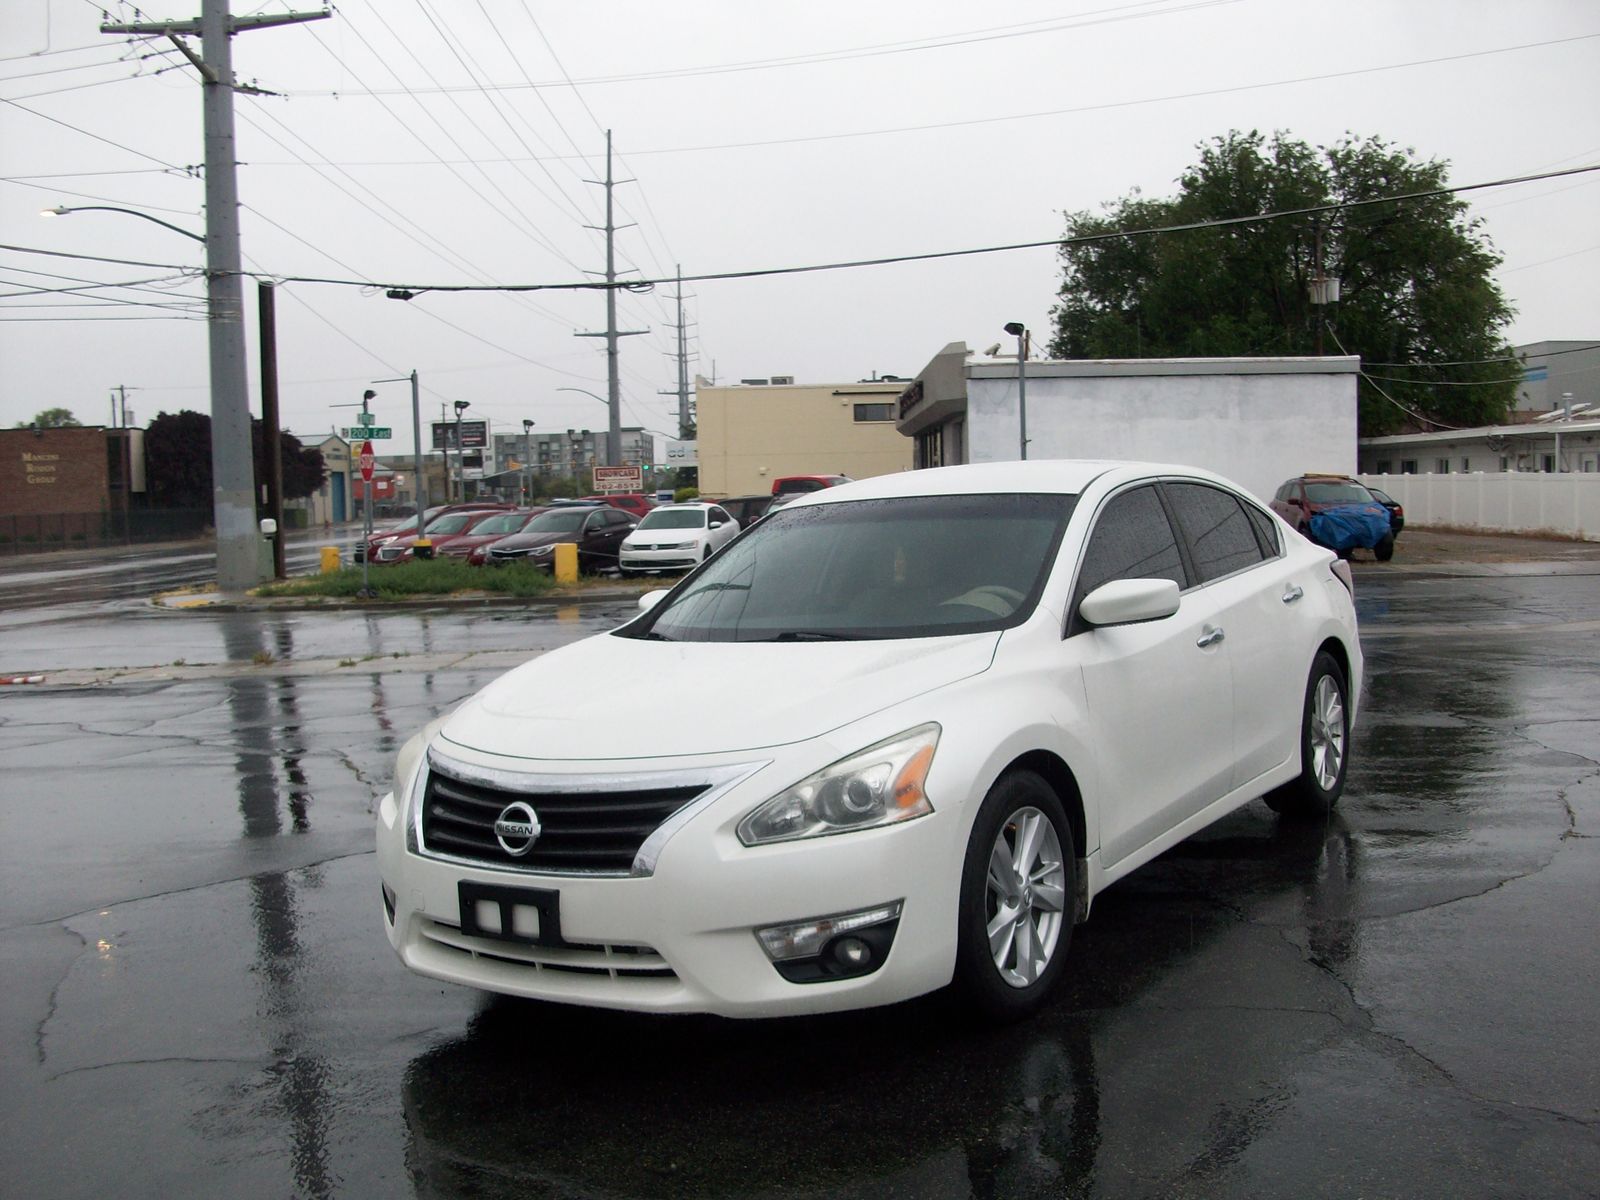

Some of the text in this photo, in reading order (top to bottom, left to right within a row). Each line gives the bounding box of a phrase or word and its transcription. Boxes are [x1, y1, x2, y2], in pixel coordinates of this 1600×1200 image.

[351, 428, 391, 438] 200 East
[598, 469, 636, 478] SHOWCASE
[496, 823, 533, 835] NISSAN
